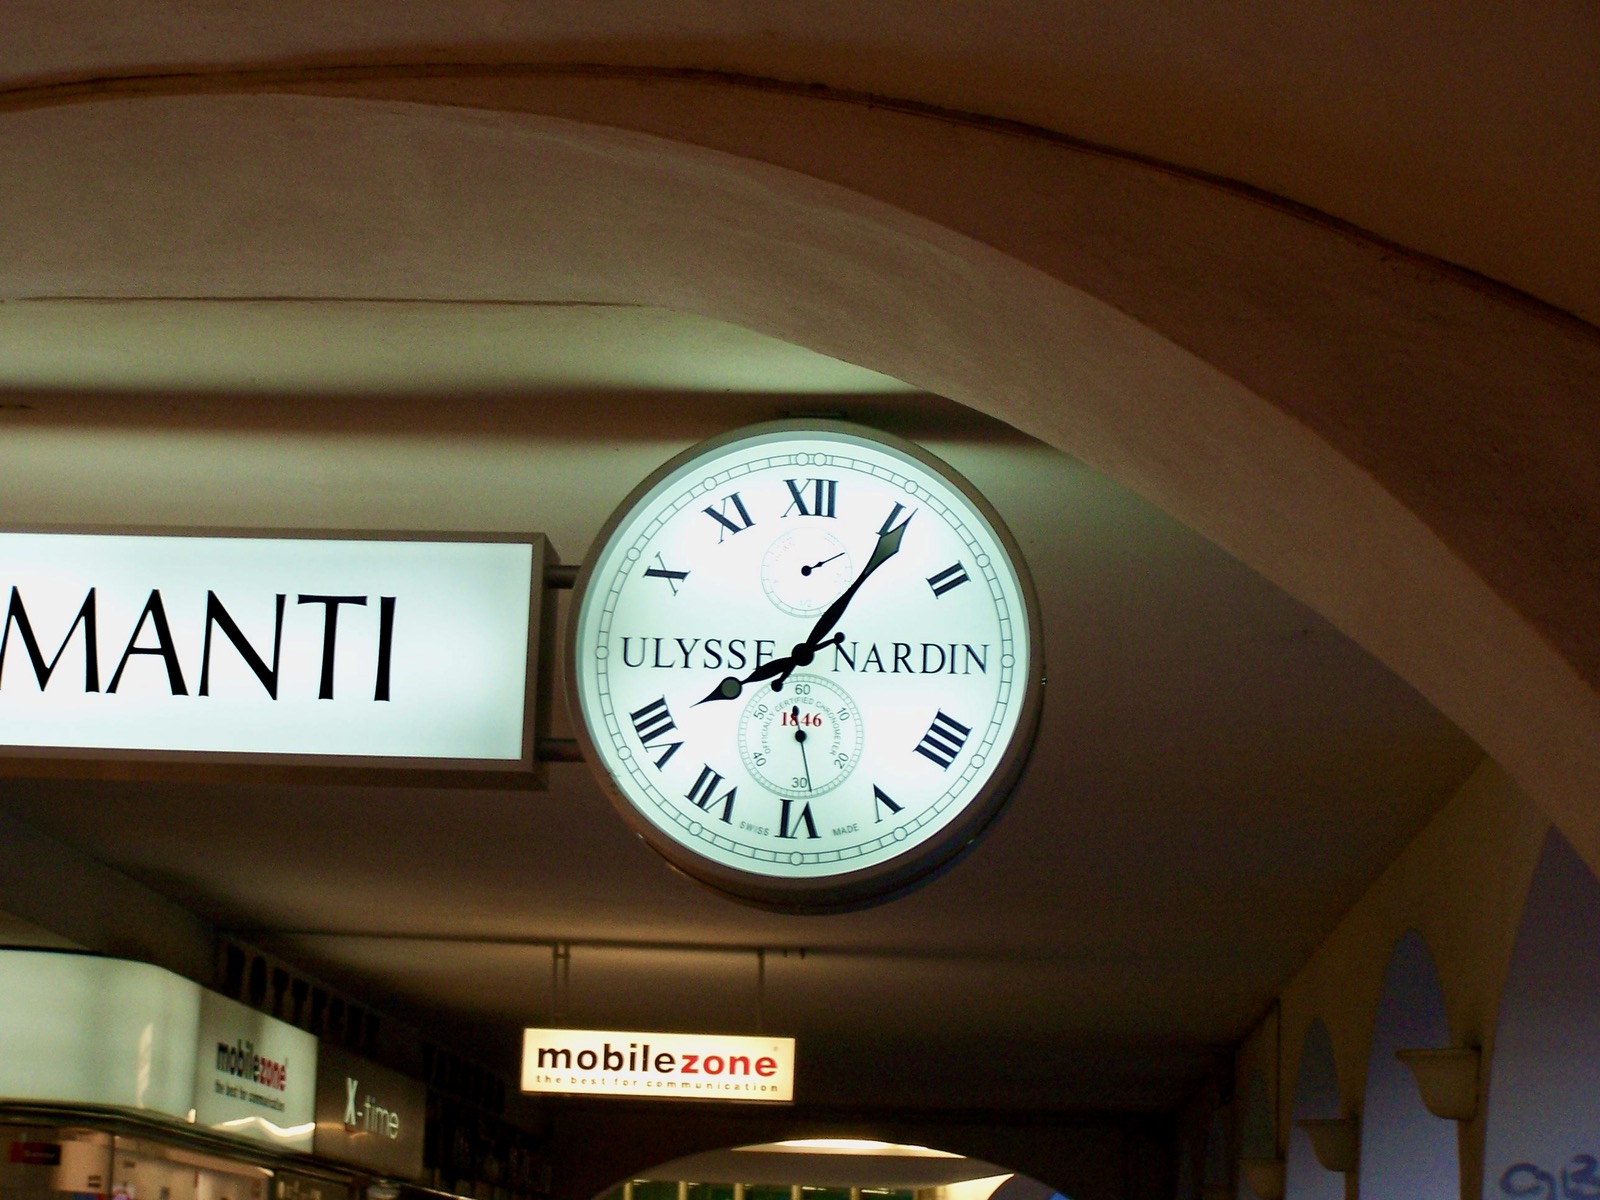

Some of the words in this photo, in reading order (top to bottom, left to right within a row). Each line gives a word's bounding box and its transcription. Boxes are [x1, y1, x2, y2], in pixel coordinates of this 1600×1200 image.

[701, 491, 756, 544] XI
[780, 478, 839, 519] XII
[643, 552, 691, 596] X
[926, 560, 972, 599] II
[0, 585, 397, 702] MANTI
[620, 636, 776, 671] ULYSSE
[831, 641, 990, 676] NARDIN
[795, 683, 811, 696] 60
[753, 703, 769, 721] 50
[775, 696, 815, 713] CERTIFIED
[815, 701, 842, 757] CHRONOMETER
[780, 711, 823, 727] 1846
[836, 706, 851, 723] 10
[629, 694, 684, 772] VIII
[912, 708, 973, 772] IIII
[752, 751, 767, 768] 40
[834, 752, 849, 770] 20
[684, 762, 739, 825] VII
[791, 777, 808, 789] 30
[774, 798, 823, 840] VI
[872, 784, 905, 824] V
[739, 821, 770, 836] SWISS
[832, 823, 860, 837] MADE
[217, 1039, 287, 1092] mobilezone
[537, 1043, 778, 1078] mobilezone
[536, 1074, 562, 1085] the
[570, 1076, 606, 1086] best
[614, 1077, 638, 1087] for
[646, 1079, 778, 1093] communication
[344, 1077, 400, 1140] X-time
